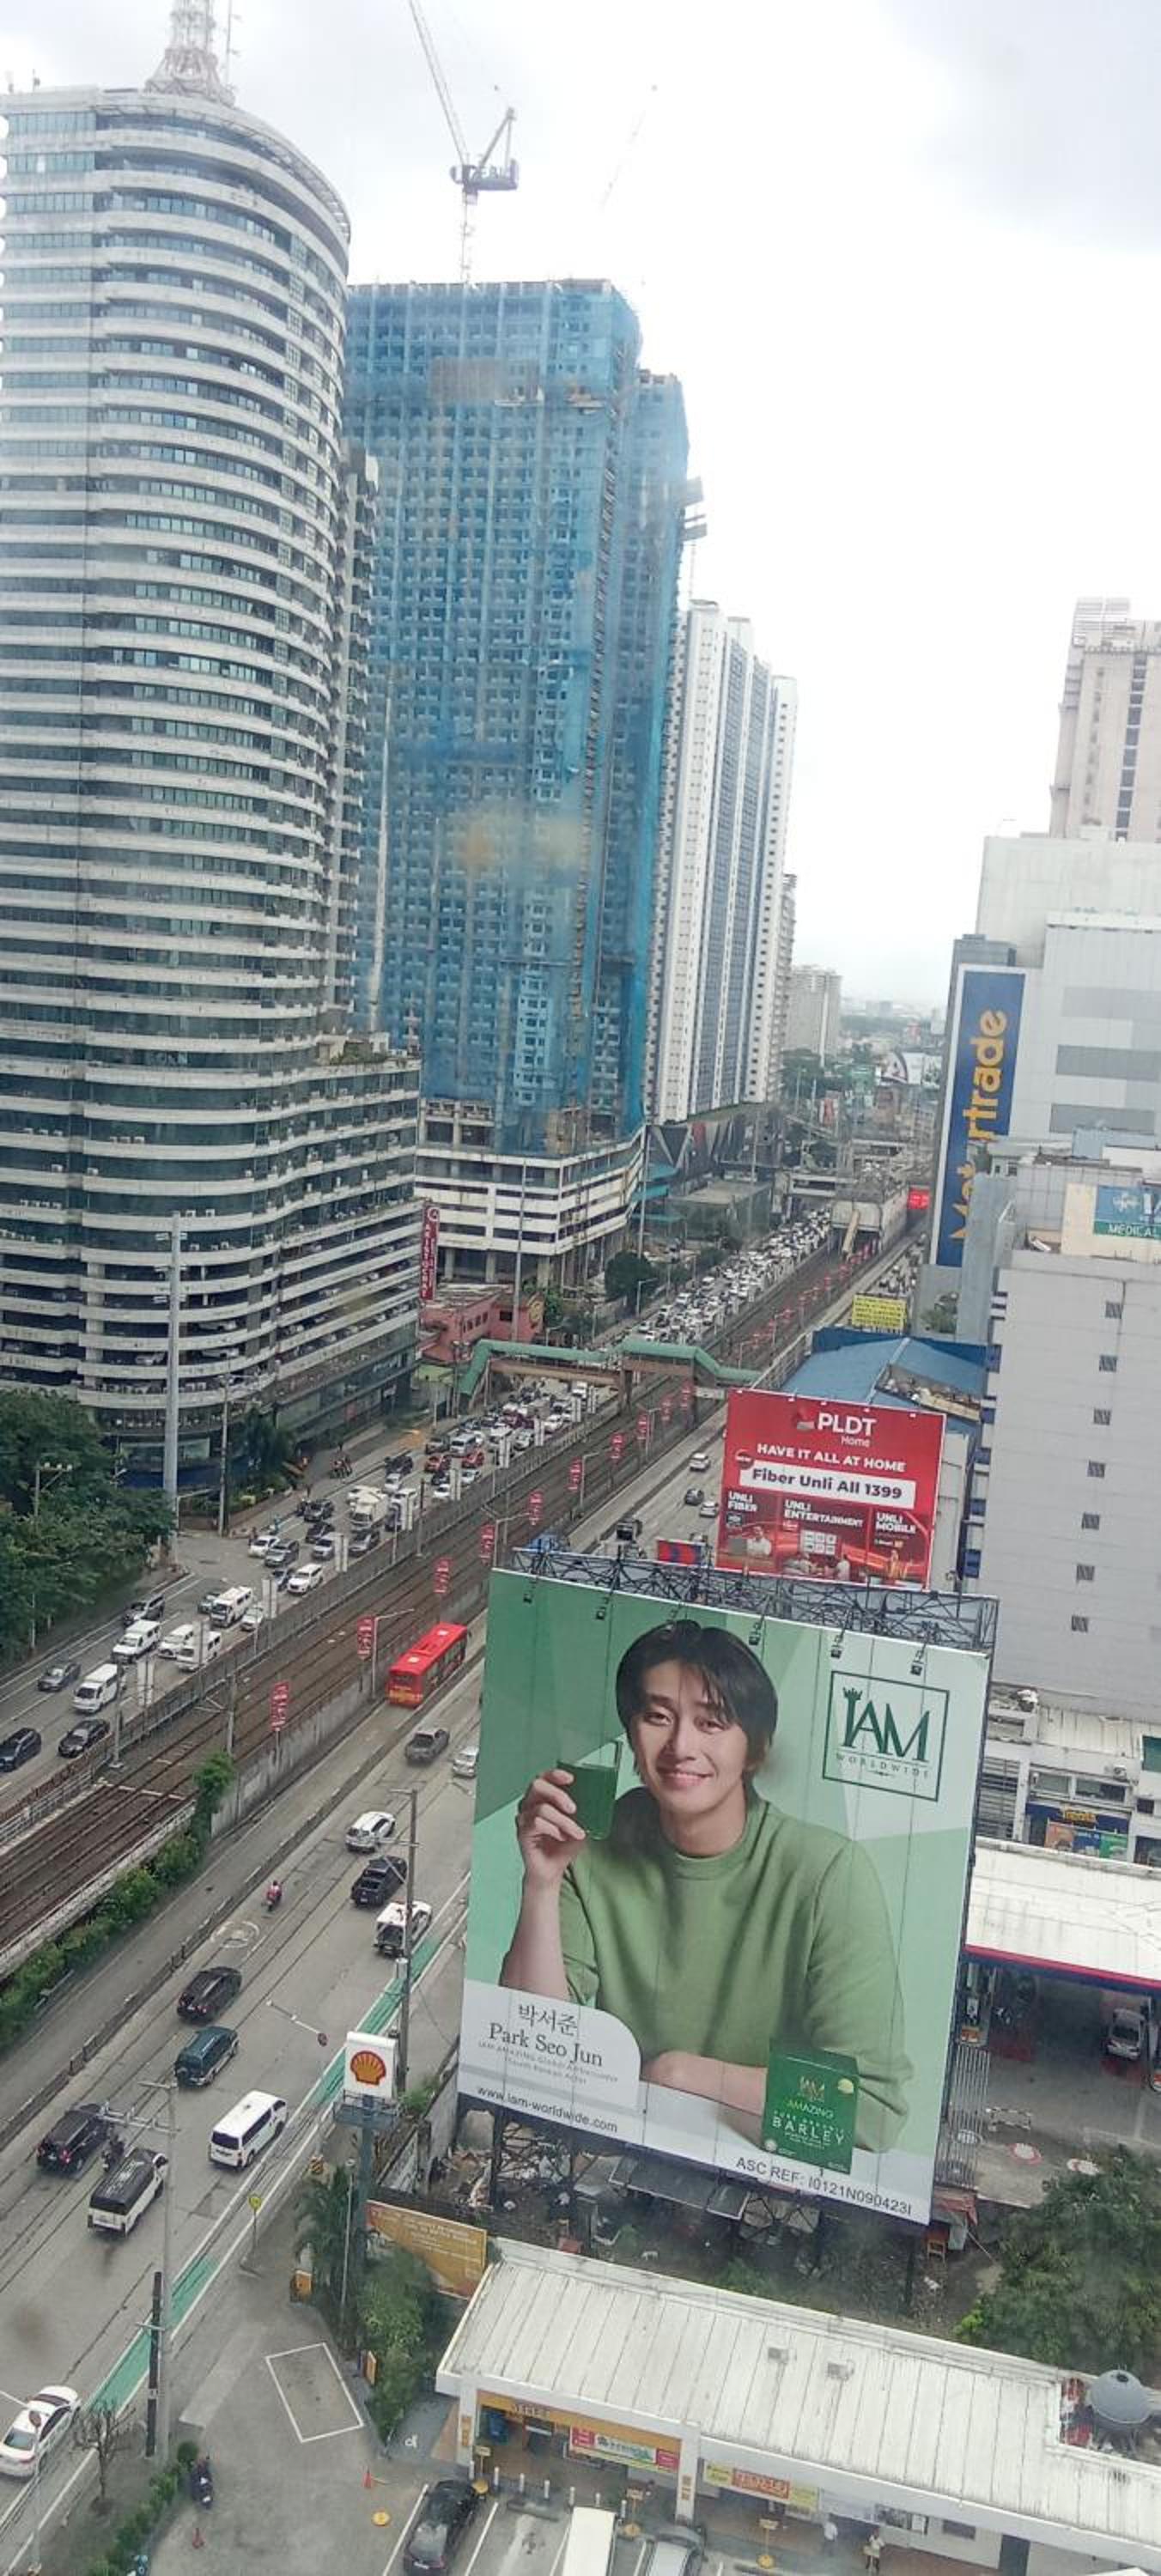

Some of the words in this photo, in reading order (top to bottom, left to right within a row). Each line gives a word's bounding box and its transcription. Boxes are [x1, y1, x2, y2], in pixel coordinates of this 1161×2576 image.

[818, 1412, 876, 1437] PLDT
[842, 1435, 870, 1448] Home
[757, 1443, 794, 1458] HAVE
[798, 1449, 811, 1459] IT
[814, 1451, 840, 1464] ALL
[842, 1455, 860, 1466] AT
[864, 1457, 907, 1473] HOME
[752, 1467, 795, 1485] Fiber
[799, 1474, 833, 1492] Unli
[837, 1480, 860, 1494] All
[865, 1483, 902, 1499] 1399
[727, 1500, 758, 1512] FIBER
[728, 1491, 753, 1504] UNLI
[784, 1499, 811, 1511] UNLI
[784, 1509, 864, 1528] ENTERTAINMENT
[875, 1522, 916, 1534] MOBILE
[876, 1511, 903, 1524] UNLI
[841, 1686, 930, 1762] IAM
[836, 1752, 930, 1779] WORLDWIDE
[518, 2004, 578, 2037] 박서준
[489, 2021, 529, 2048] Park
[535, 2033, 568, 2057] Seo
[569, 2043, 603, 2067] Jun
[477, 2087, 618, 2134] www.iam-worldwide.com
[772, 2115, 844, 2146] BARLEY
[735, 2155, 766, 2176] ASC
[769, 2165, 805, 2184] REF:
